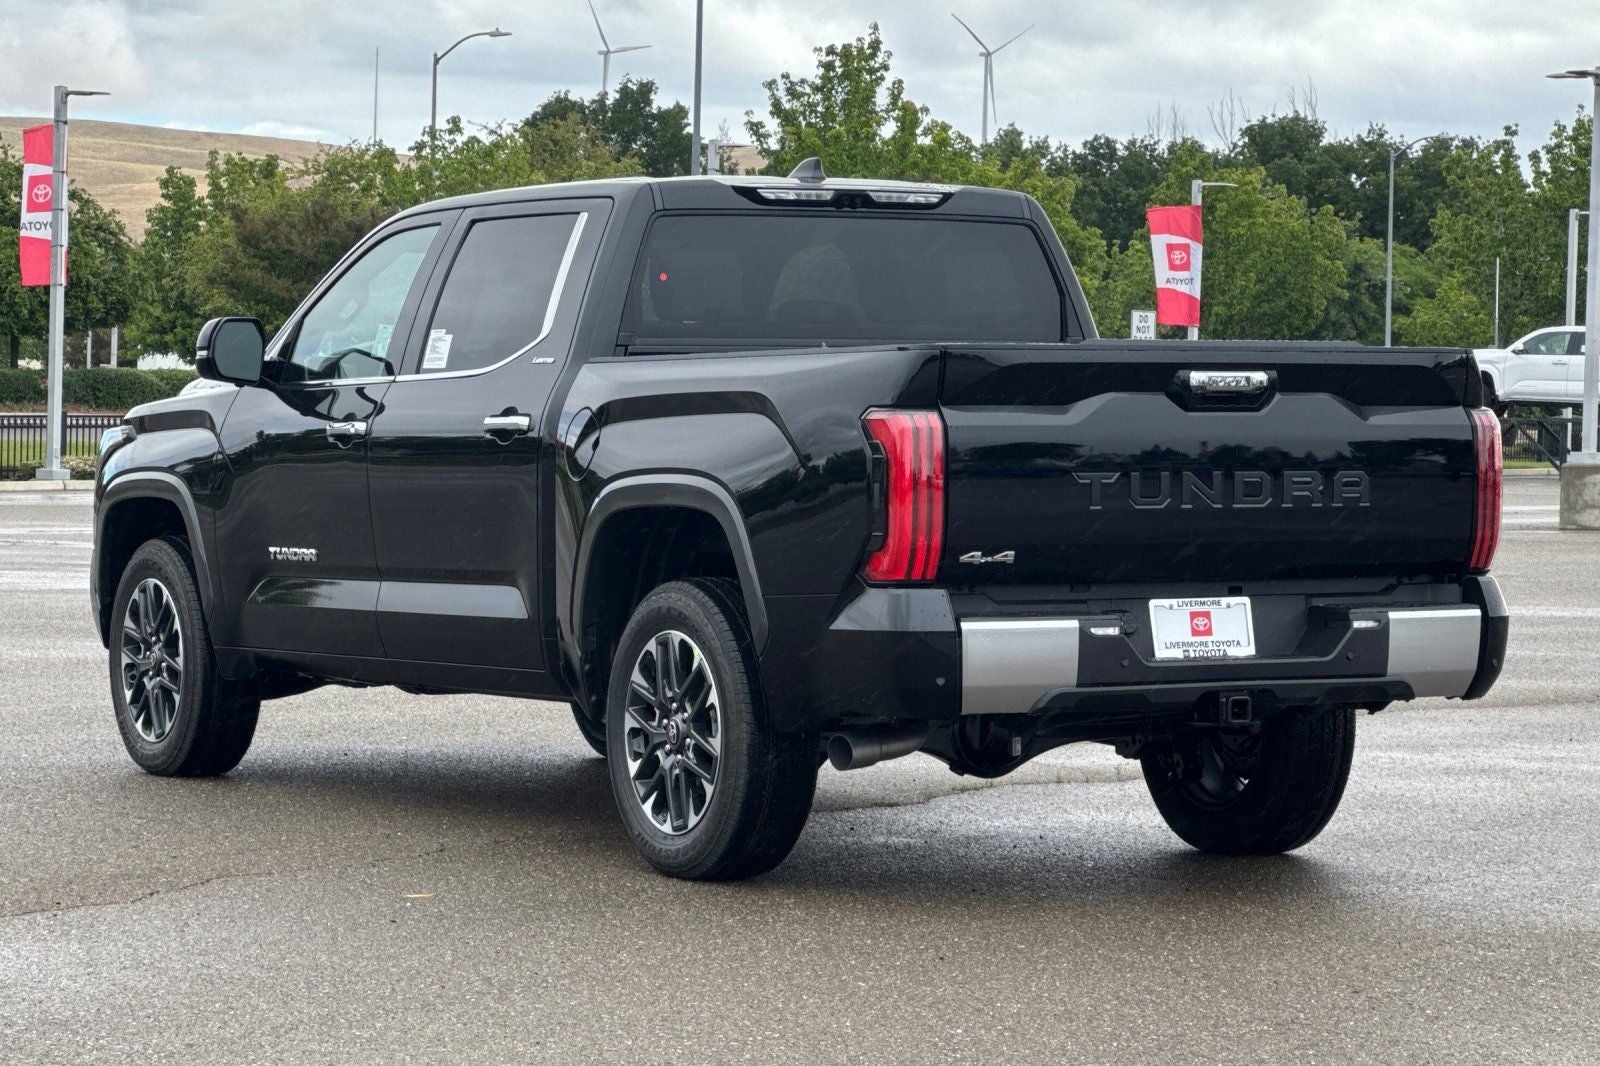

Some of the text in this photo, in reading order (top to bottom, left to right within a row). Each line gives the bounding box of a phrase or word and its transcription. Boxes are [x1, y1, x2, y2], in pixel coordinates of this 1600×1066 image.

[1138, 314, 1149, 324] DO
[1136, 325, 1151, 335] NOT
[1072, 470, 1371, 510] TUNDRA
[268, 546, 319, 562] TUNDRA
[1177, 600, 1223, 608] LIVERMORE
[1165, 640, 1242, 650] LIVERMORE TOYOTA
[1192, 649, 1228, 657] TOYOTA
